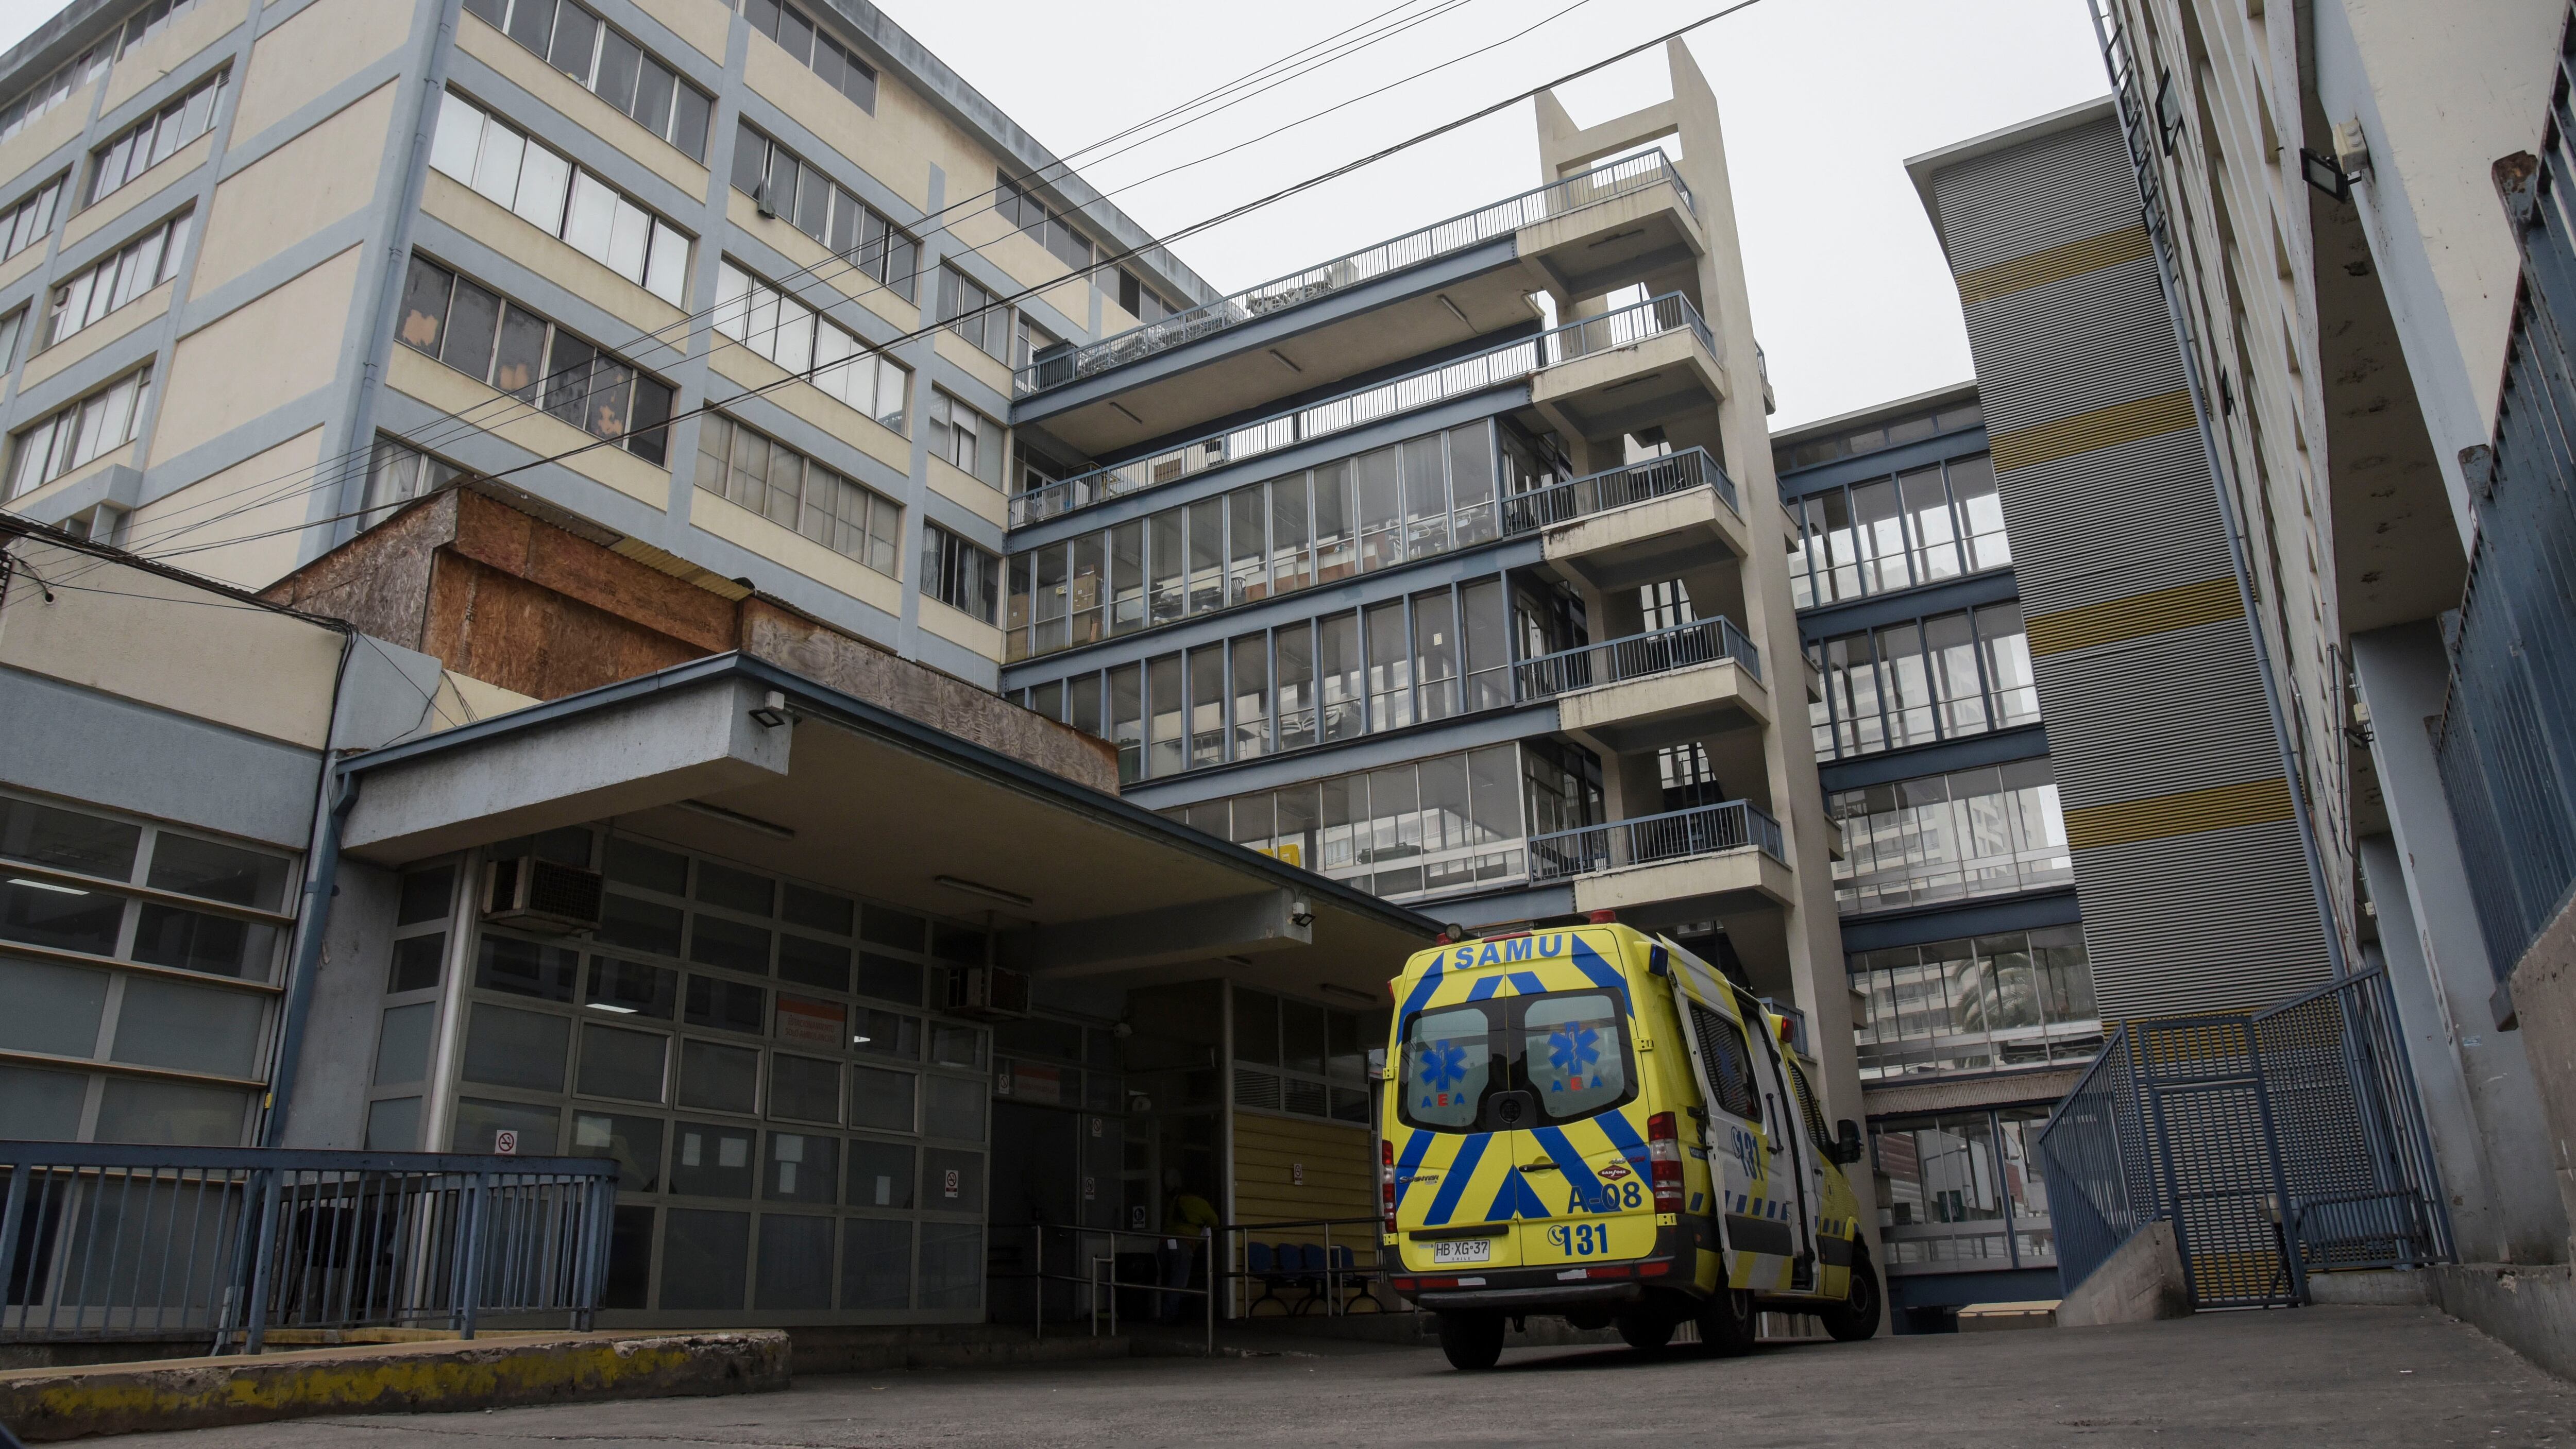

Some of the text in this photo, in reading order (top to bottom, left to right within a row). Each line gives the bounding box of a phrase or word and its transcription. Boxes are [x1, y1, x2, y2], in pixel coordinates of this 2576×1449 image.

[1454, 934, 1562, 970] SAMU
[1736, 1130, 1765, 1182] 131
[1567, 1181, 1642, 1214] A-08
[1558, 1223, 1608, 1256] 131
